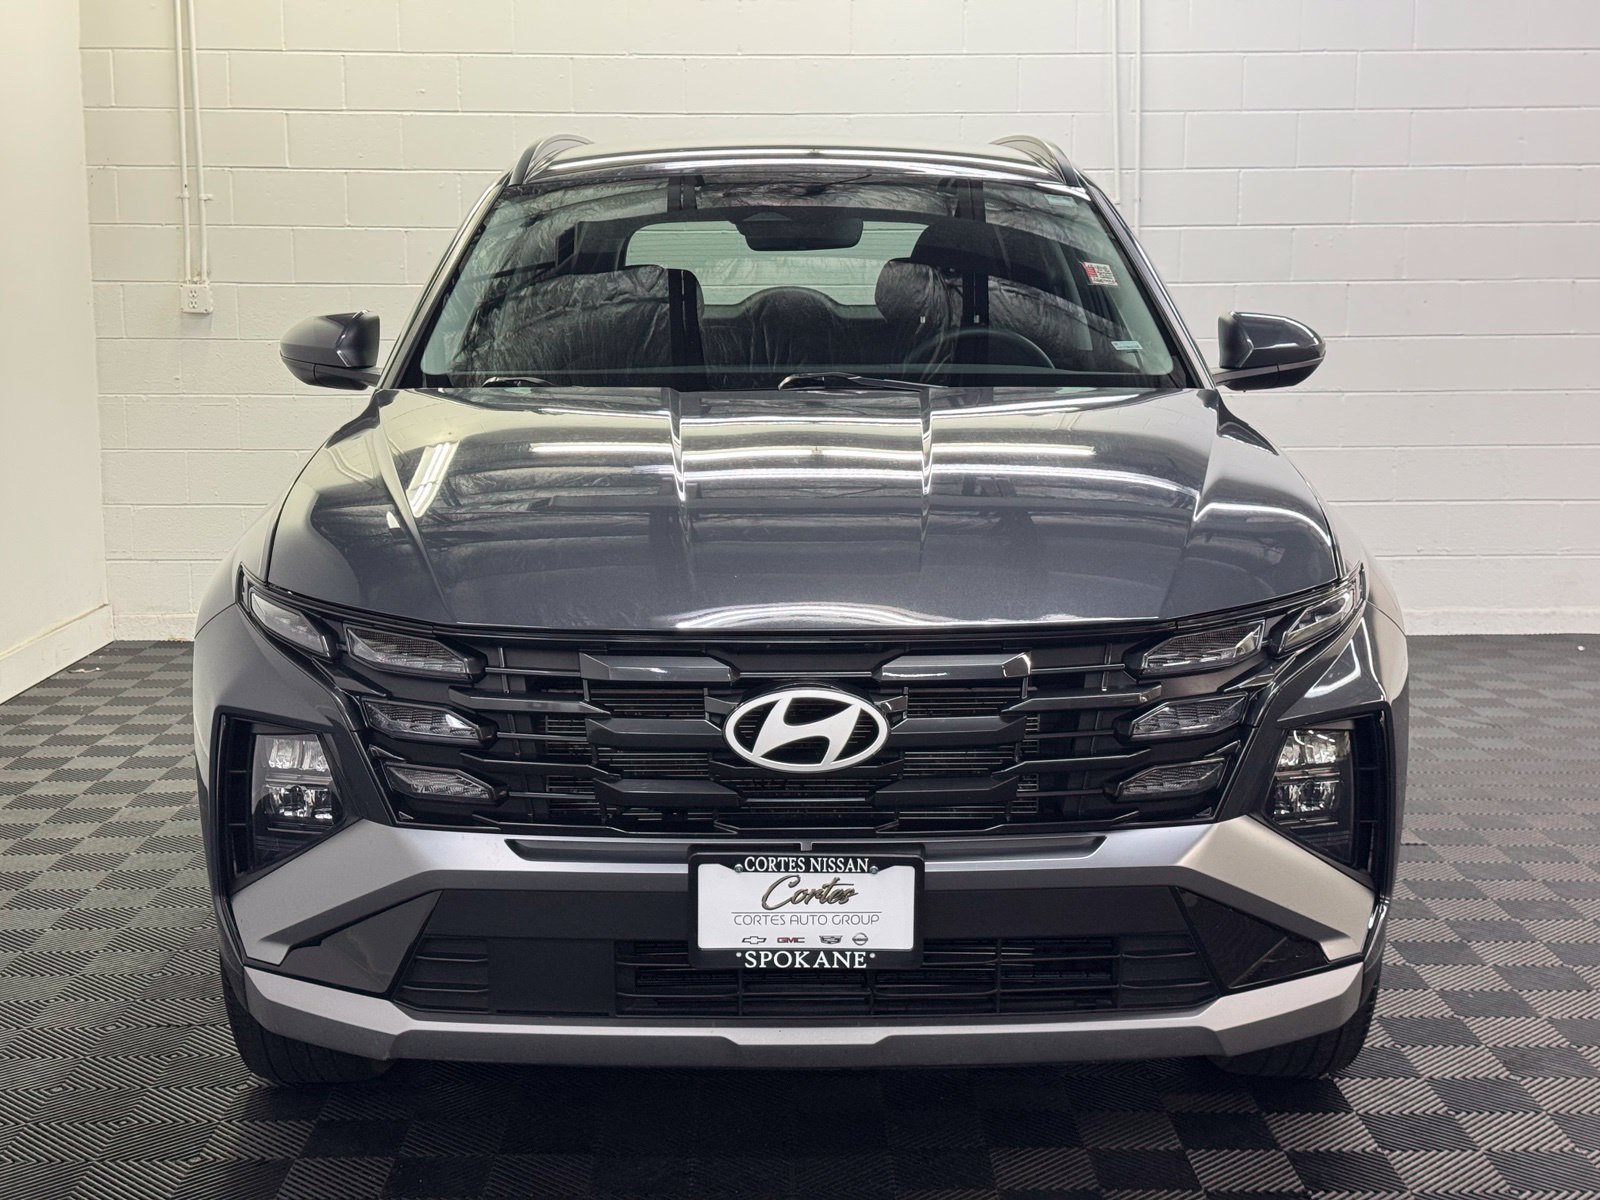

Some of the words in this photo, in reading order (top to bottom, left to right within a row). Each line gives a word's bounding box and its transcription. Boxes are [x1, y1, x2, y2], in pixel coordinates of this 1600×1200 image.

[744, 856, 806, 872] CORTES
[809, 857, 869, 873] NISSAN
[761, 874, 859, 911] Cortes
[733, 914, 786, 926] CORTES
[789, 914, 828, 926] AUTO
[831, 914, 880, 926] GROUP
[776, 936, 806, 944] GMC
[744, 950, 868, 970] SPOKANE
